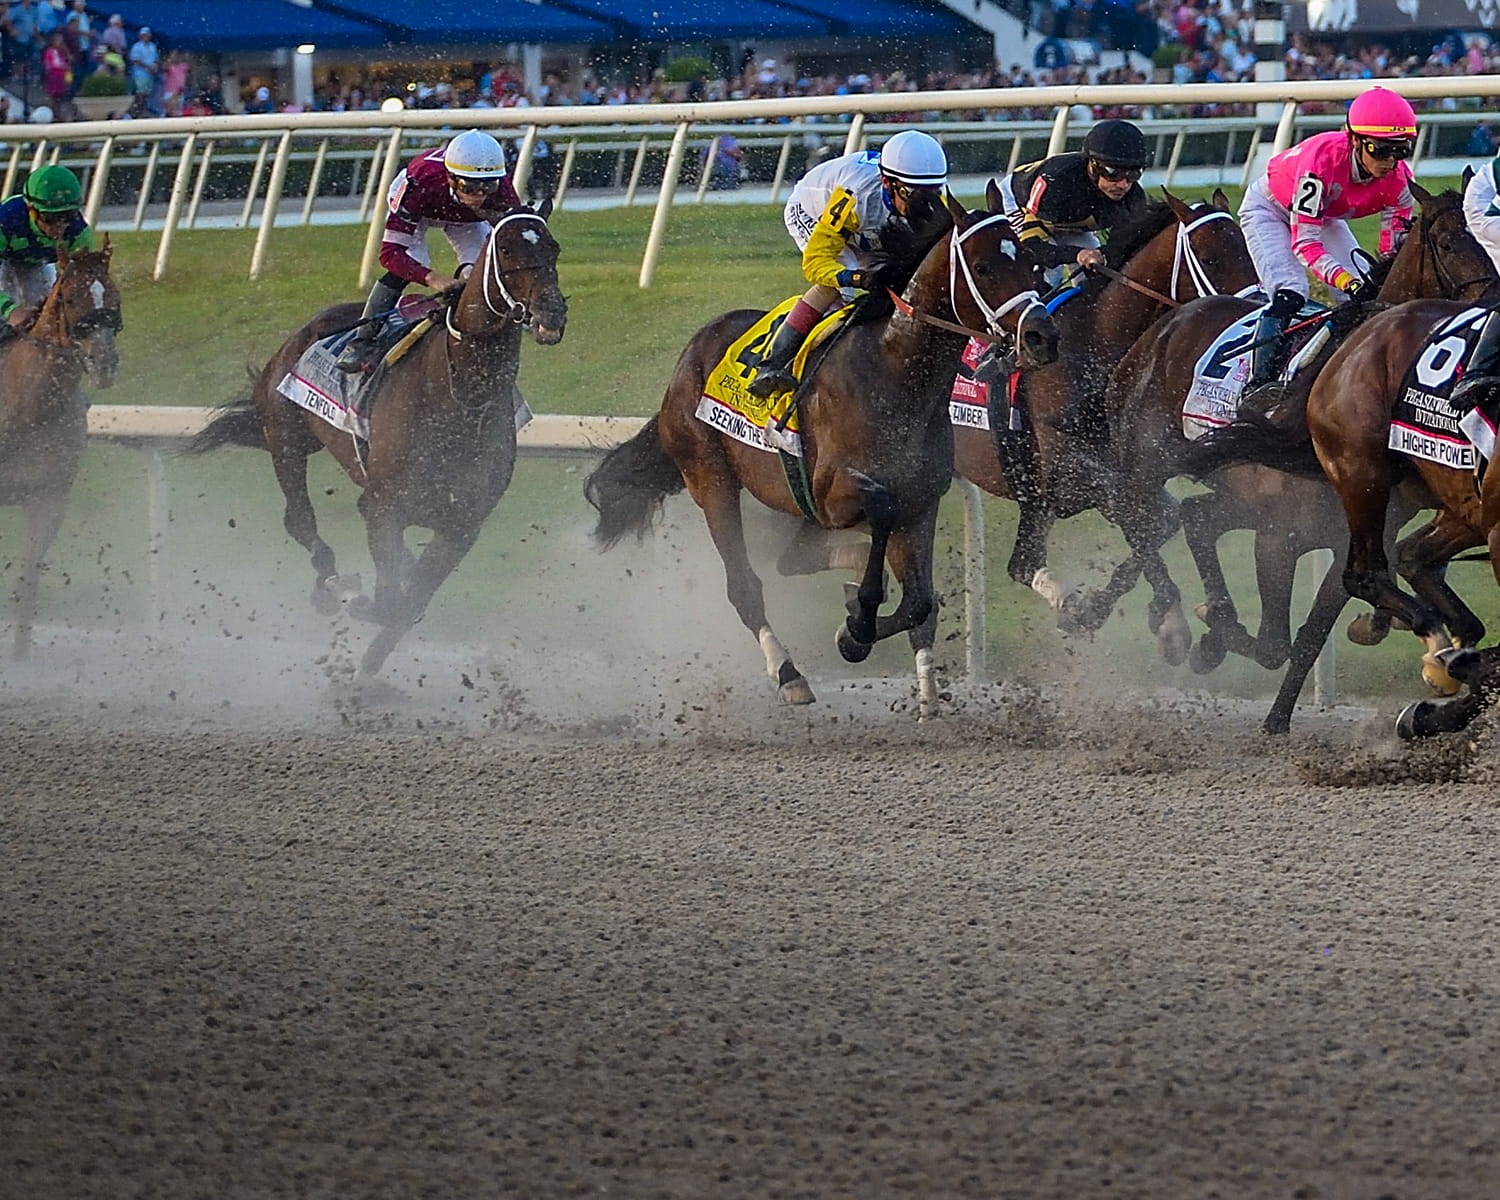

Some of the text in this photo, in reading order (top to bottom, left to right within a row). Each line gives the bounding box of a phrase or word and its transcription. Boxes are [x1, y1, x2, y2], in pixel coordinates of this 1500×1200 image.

[829, 197, 850, 227] 4
[1298, 181, 1317, 214] 2
[736, 311, 790, 379] 4
[1416, 307, 1488, 388] 6
[304, 389, 336, 421] TENFOLD
[709, 406, 747, 441] SEEKING
[745, 425, 763, 445] THE
[1401, 431, 1437, 458] HIGHER
